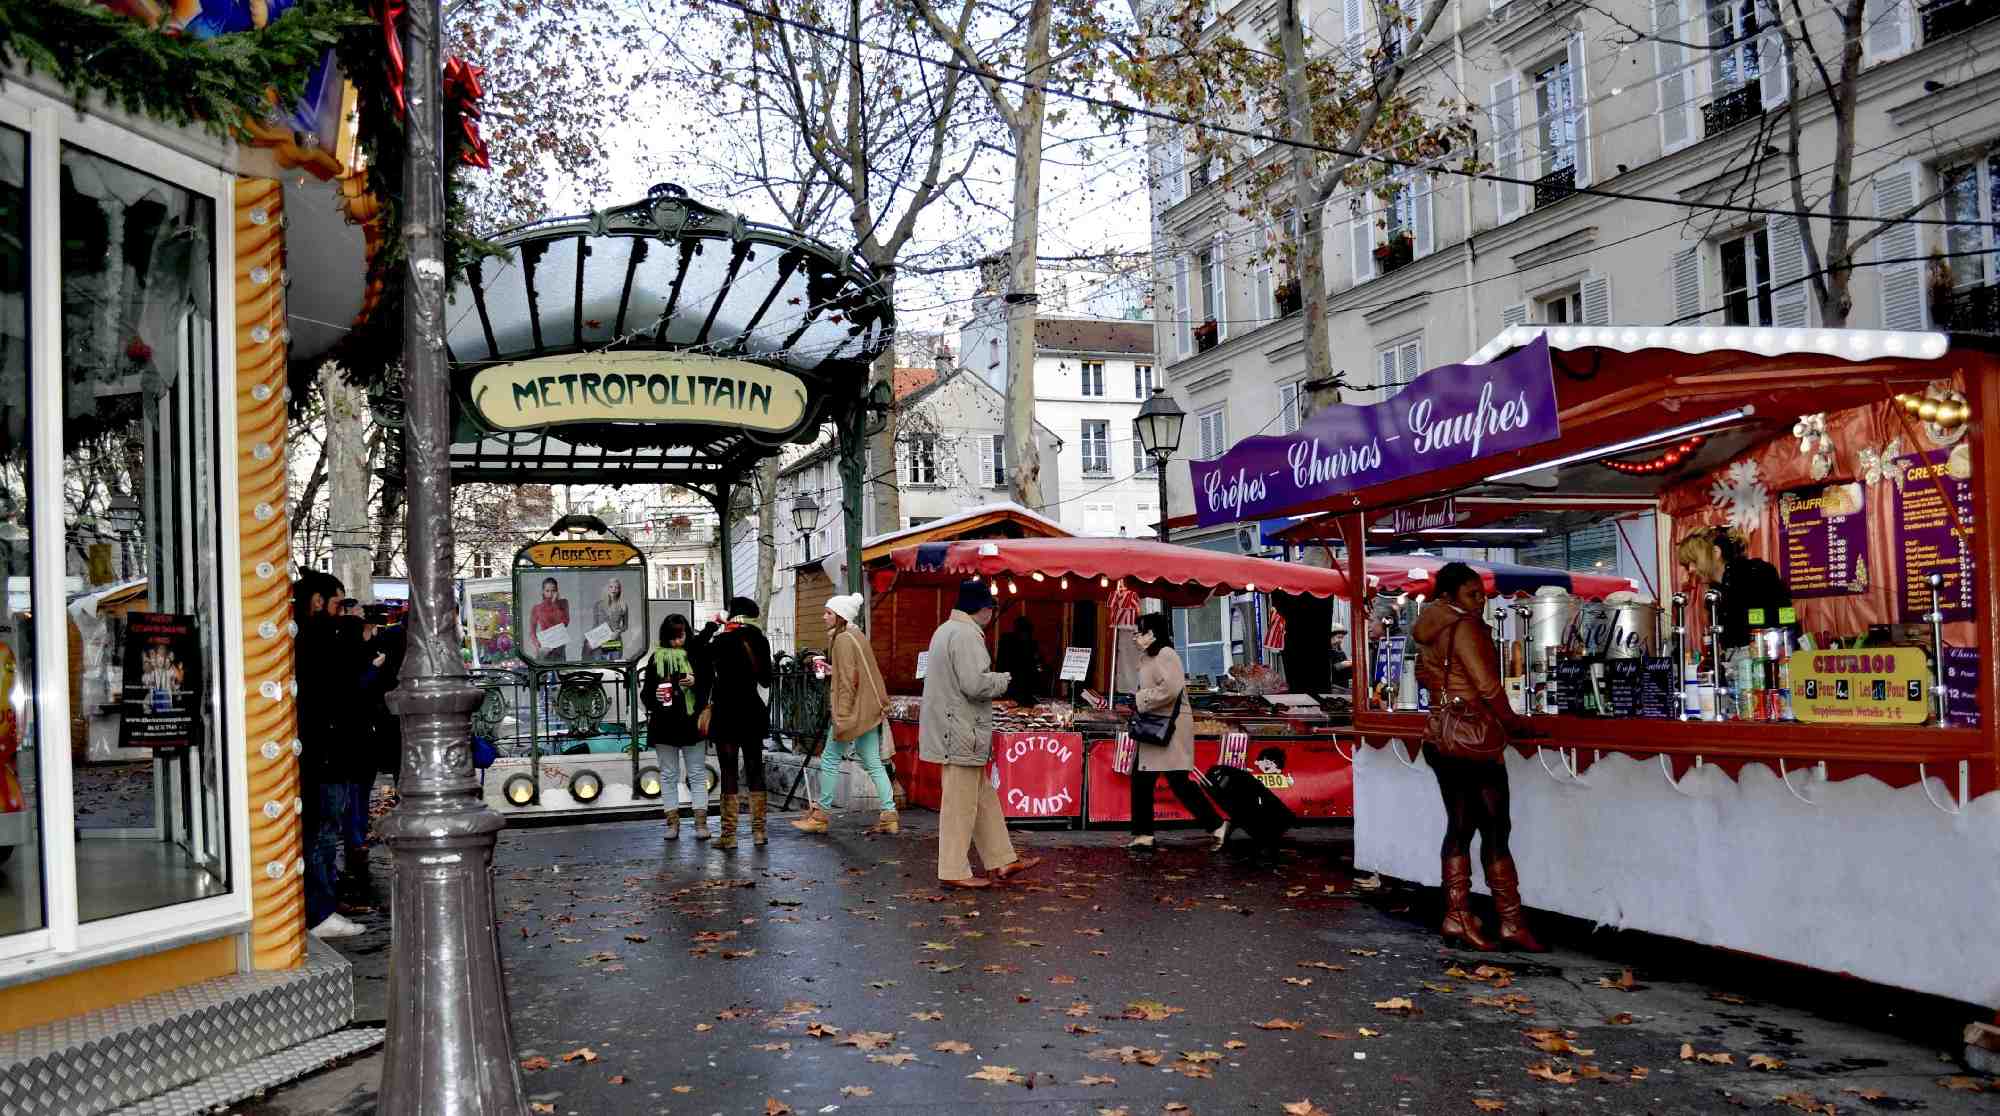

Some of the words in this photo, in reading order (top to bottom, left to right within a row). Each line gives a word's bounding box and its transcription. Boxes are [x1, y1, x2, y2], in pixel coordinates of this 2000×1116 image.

[512, 372, 772, 415] METROPOLITAIN
[1204, 467, 1267, 518] Crêpes
[1288, 436, 1381, 488] Churros
[1408, 382, 1528, 458] Gaufres
[1813, 654, 1896, 673] CHURROS
[1948, 667, 1956, 677] 8
[1806, 681, 1815, 697] 8
[1909, 681, 1920, 698] 5
[1948, 688, 1960, 699] 12
[1006, 736, 1072, 763] COTTON
[1008, 787, 1072, 815] CANDY
